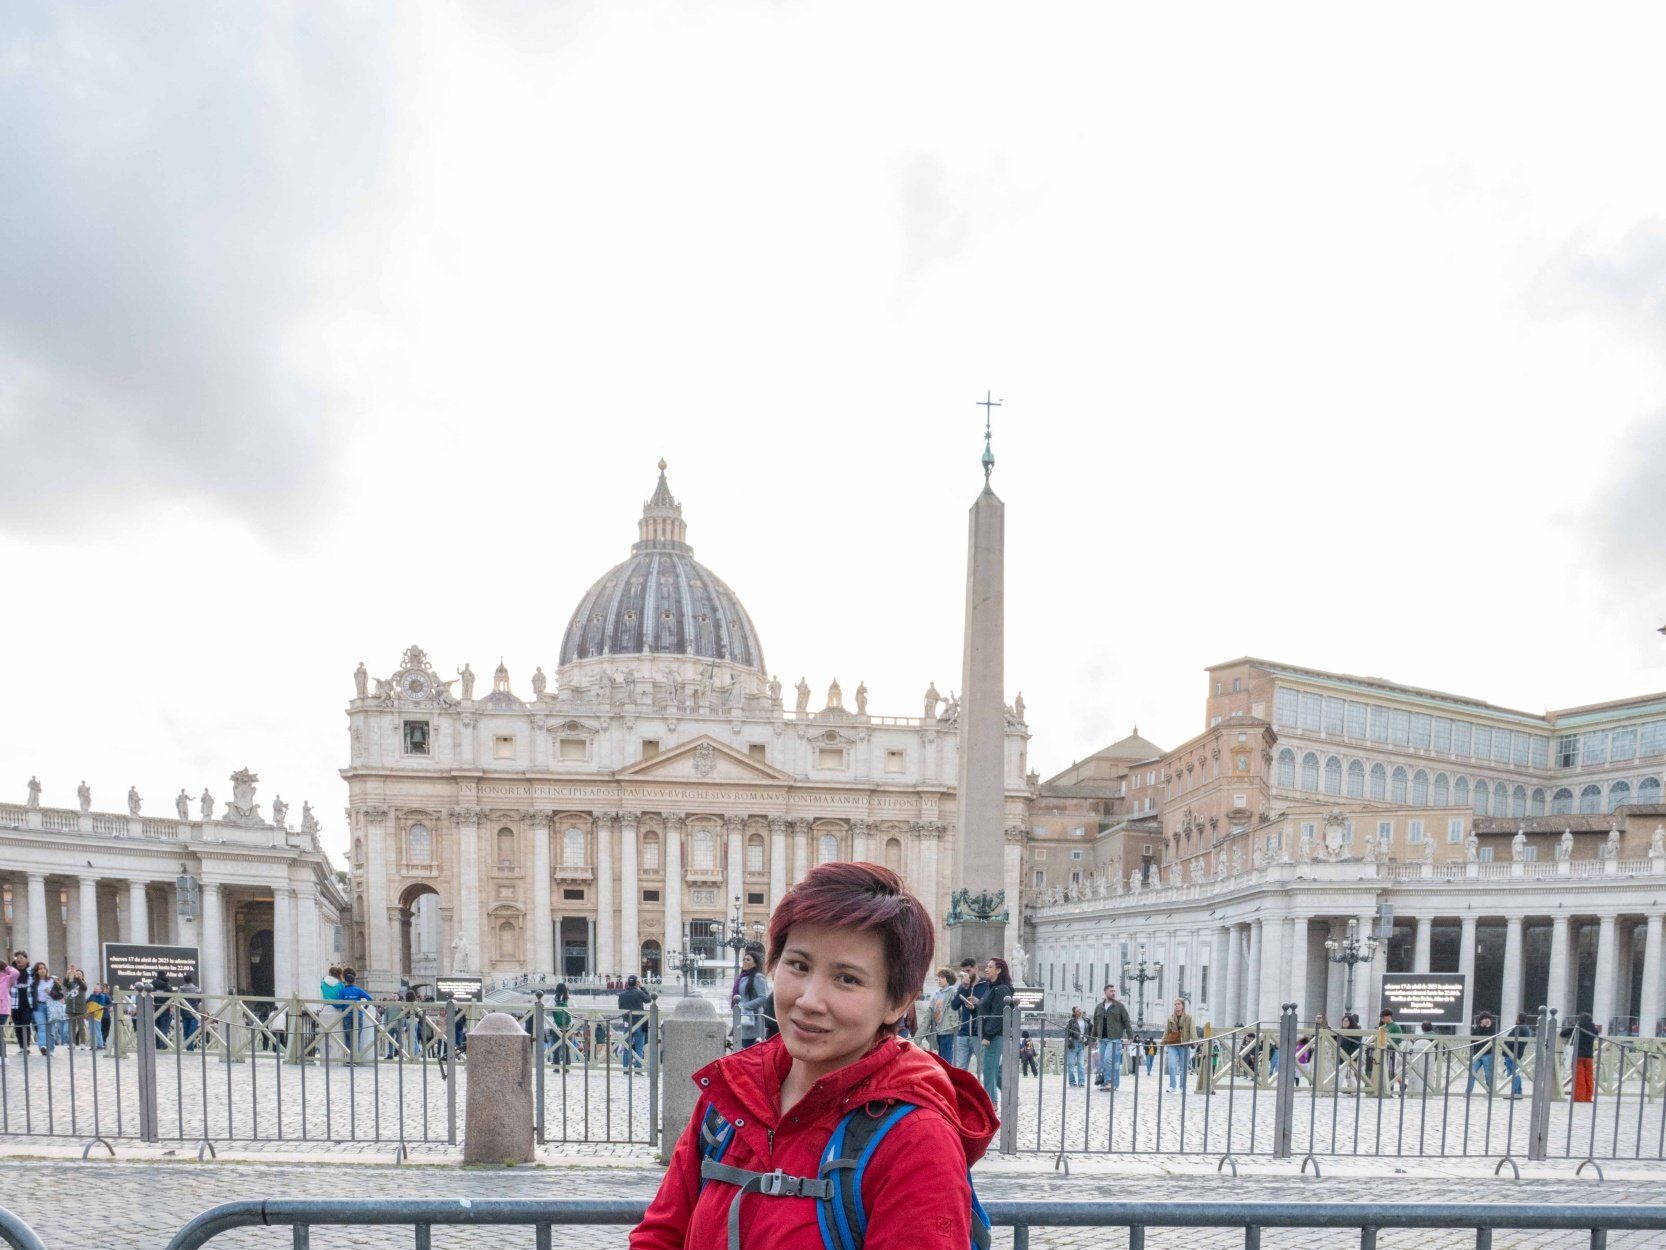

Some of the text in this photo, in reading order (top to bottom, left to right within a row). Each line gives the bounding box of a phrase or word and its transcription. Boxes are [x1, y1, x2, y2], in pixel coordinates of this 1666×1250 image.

[460, 784, 473, 793] IN
[477, 785, 531, 796] HONOREM
[534, 786, 588, 796] PRINCIPIS
[668, 790, 732, 800] BVRGHESIVS
[734, 792, 786, 800] ROMANVS
